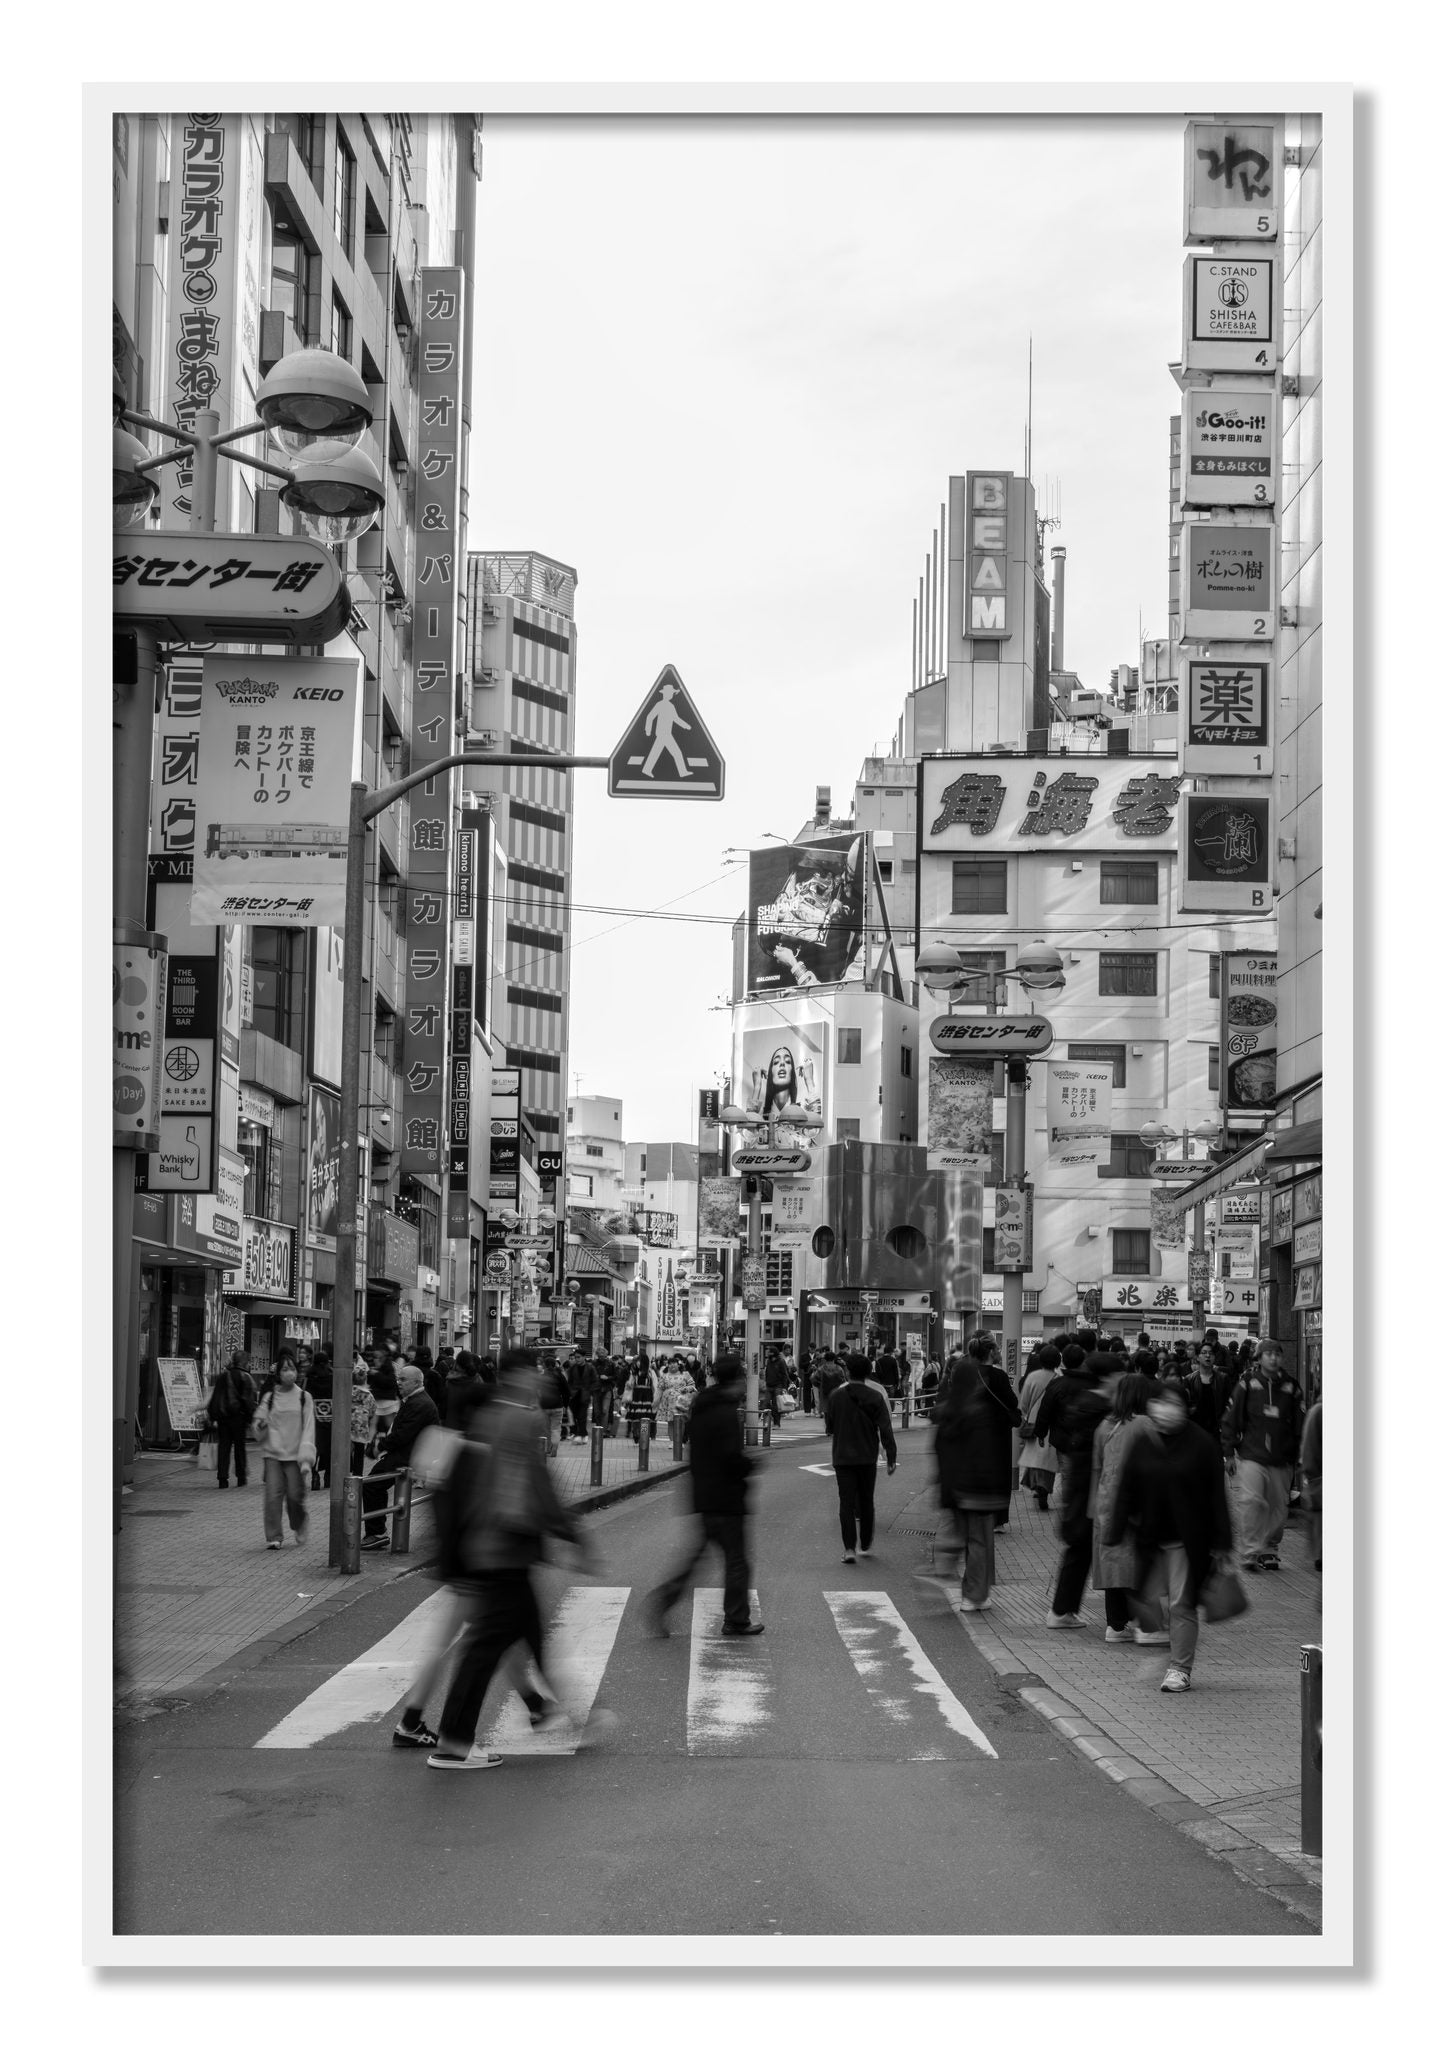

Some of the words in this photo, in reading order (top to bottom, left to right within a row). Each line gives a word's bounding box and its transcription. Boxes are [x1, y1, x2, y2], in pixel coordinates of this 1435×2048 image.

[181, 127, 225, 272] カラオケ
[1257, 216, 1269, 232] 5
[1210, 267, 1257, 276] C.STAND
[1210, 310, 1257, 320] SHISHA
[1210, 322, 1257, 330] CAFE&BAR
[1255, 350, 1268, 366] 4
[1208, 412, 1265, 429] Goo-it!
[1201, 433, 1262, 443] 渋谷宇田川町店
[1195, 460, 1267, 472] 全身もみほぐし
[1254, 484, 1267, 501] 3
[971, 477, 1005, 628] BEAM
[1196, 559, 1264, 580] ポムの樹
[1253, 618, 1266, 634] 2
[293, 688, 344, 701] KEIO
[1200, 670, 1253, 723] 薬
[1194, 726, 1258, 741] マツモトキヨシ
[234, 725, 251, 770] 冒険へ
[254, 725, 272, 804] カントーの
[275, 725, 294, 804] ポケパーク
[298, 726, 316, 789] 京王線で
[1253, 755, 1262, 770] 1
[930, 772, 1184, 836] 角海老
[1194, 813, 1257, 864] 一蘭
[460, 835, 469, 872] kimono
[221, 897, 314, 910] 渋谷センター街
[1252, 890, 1264, 906] B
[459, 923, 468, 935] HAIR
[1231, 973, 1277, 986] 四川料理
[405, 894, 443, 1149] カラオケ館
[113, 1030, 151, 1049] me
[937, 1025, 1046, 1039] 渋谷センター街
[1228, 1034, 1258, 1055] 6F
[123, 1087, 143, 1100] Day!
[1070, 1087, 1078, 1118] カントーの
[160, 1154, 194, 1166] Whisky
[540, 1158, 561, 1169] GU
[736, 1155, 801, 1164] 渋谷センター街
[159, 1165, 180, 1173] Bank
[1154, 1165, 1213, 1174] 渋谷センター街
[1117, 1284, 1179, 1306] 兆楽
[665, 1282, 674, 1326] BEER
